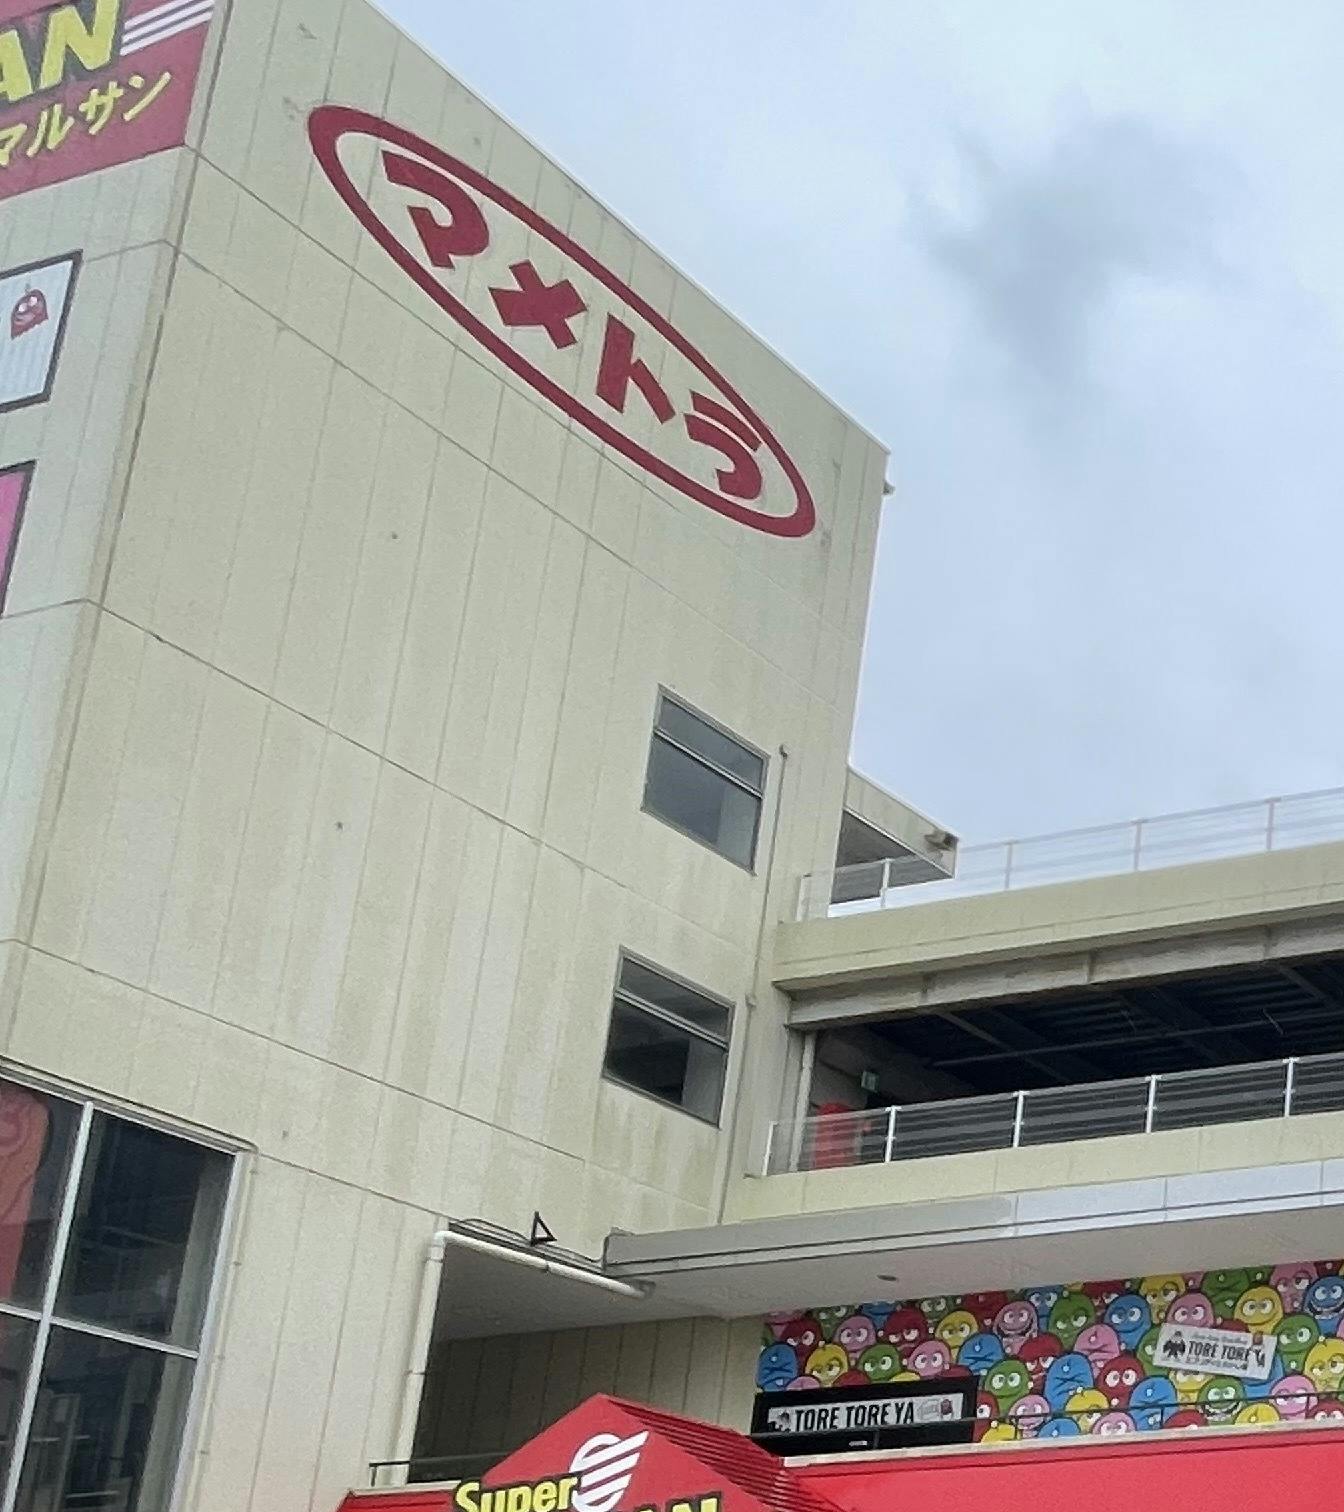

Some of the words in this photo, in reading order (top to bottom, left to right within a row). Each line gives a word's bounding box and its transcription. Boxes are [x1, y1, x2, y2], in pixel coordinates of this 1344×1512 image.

[380, 150, 763, 501] マメトラ
[1187, 1340, 1219, 1358] TORE
[1221, 1344, 1252, 1362] TORE
[795, 1406, 840, 1432] TORE
[846, 1402, 891, 1428] TORE
[894, 1401, 915, 1425] YA
